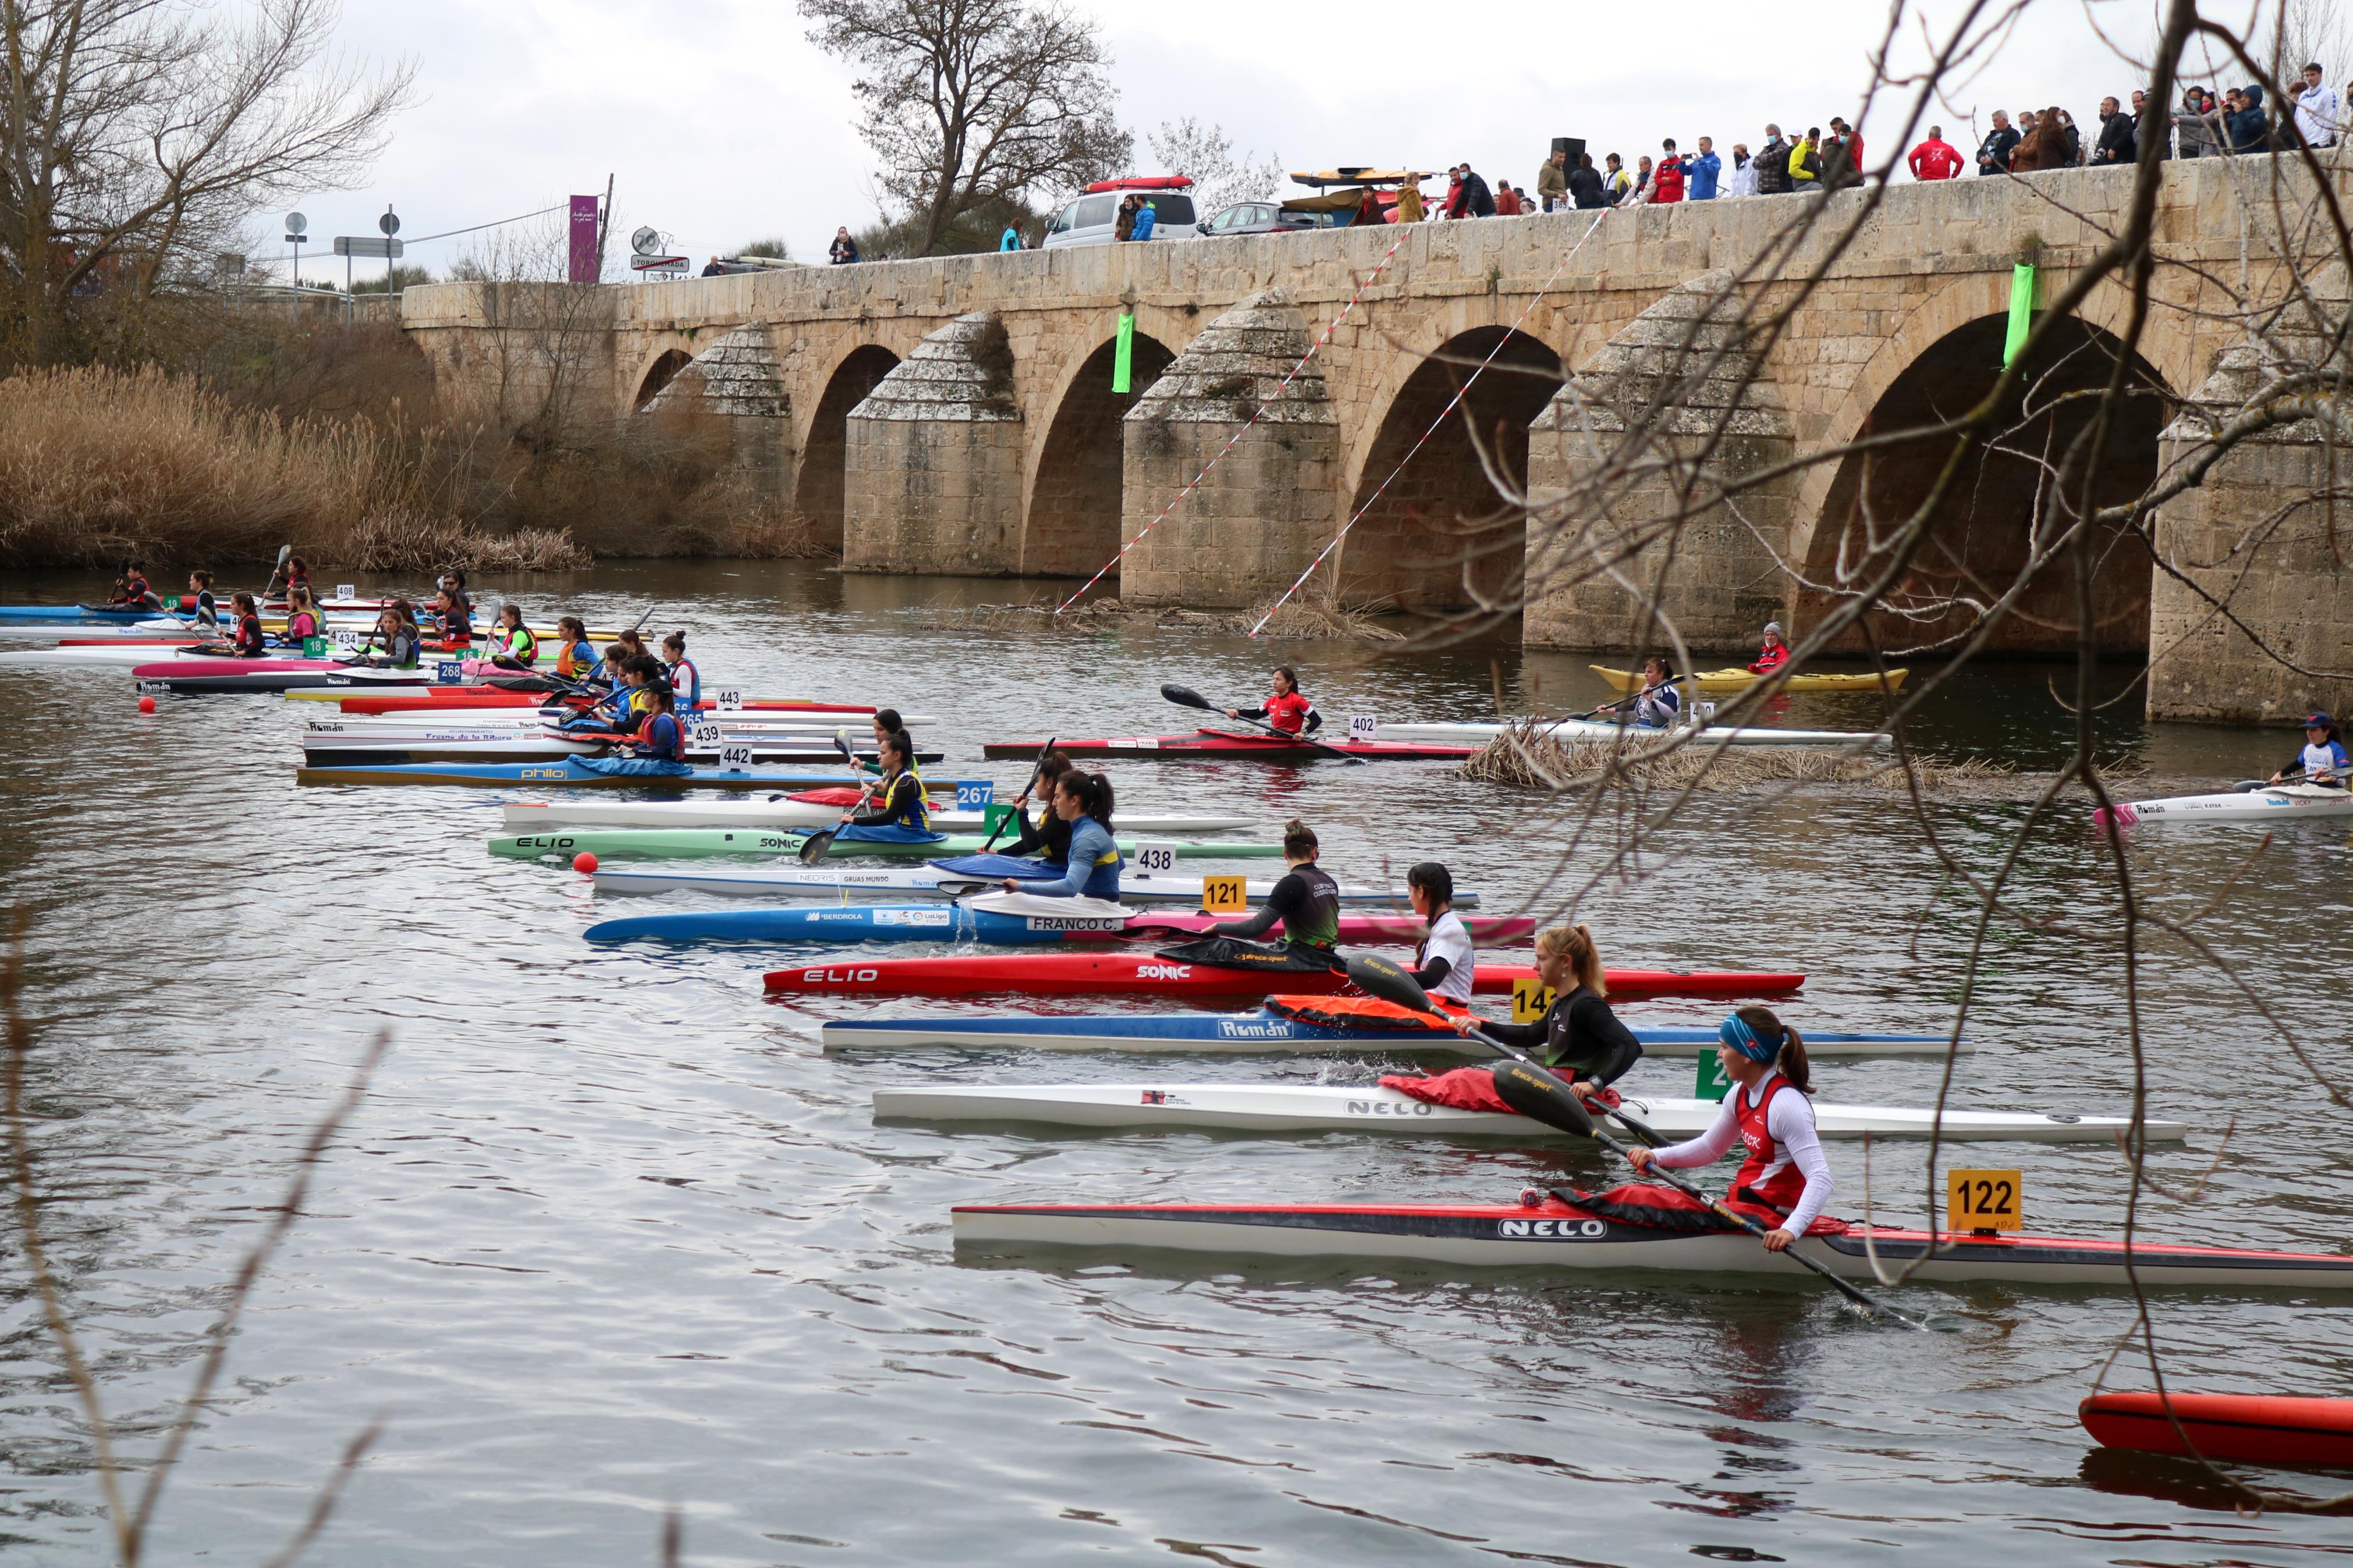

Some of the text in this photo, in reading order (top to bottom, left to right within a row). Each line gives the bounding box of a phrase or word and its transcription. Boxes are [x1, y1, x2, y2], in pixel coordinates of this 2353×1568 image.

[637, 259, 684, 268] TORQUEMADA
[339, 586, 353, 595] 408
[168, 599, 178, 608] 19
[339, 634, 356, 644] 434
[310, 641, 321, 652] 18
[441, 665, 460, 677] 268
[719, 692, 740, 704] 443
[310, 723, 344, 731] Román
[1353, 718, 1374, 731] 402
[696, 725, 719, 742] 439
[723, 748, 748, 763] 442
[521, 768, 564, 779] philo
[958, 787, 992, 803] 267
[516, 838, 574, 848] ELIO
[759, 838, 802, 849] SONIC
[1140, 849, 1172, 870] 438
[1207, 883, 1237, 905] 121
[1034, 918, 1116, 930] FRANCO C.
[803, 969, 878, 982] ELIO
[1135, 963, 1192, 981] SONIC
[1220, 1021, 1289, 1036] Román
[1347, 1101, 1432, 1116] NELO
[1957, 1180, 2012, 1214] 122
[1503, 1219, 1603, 1236] NELO
